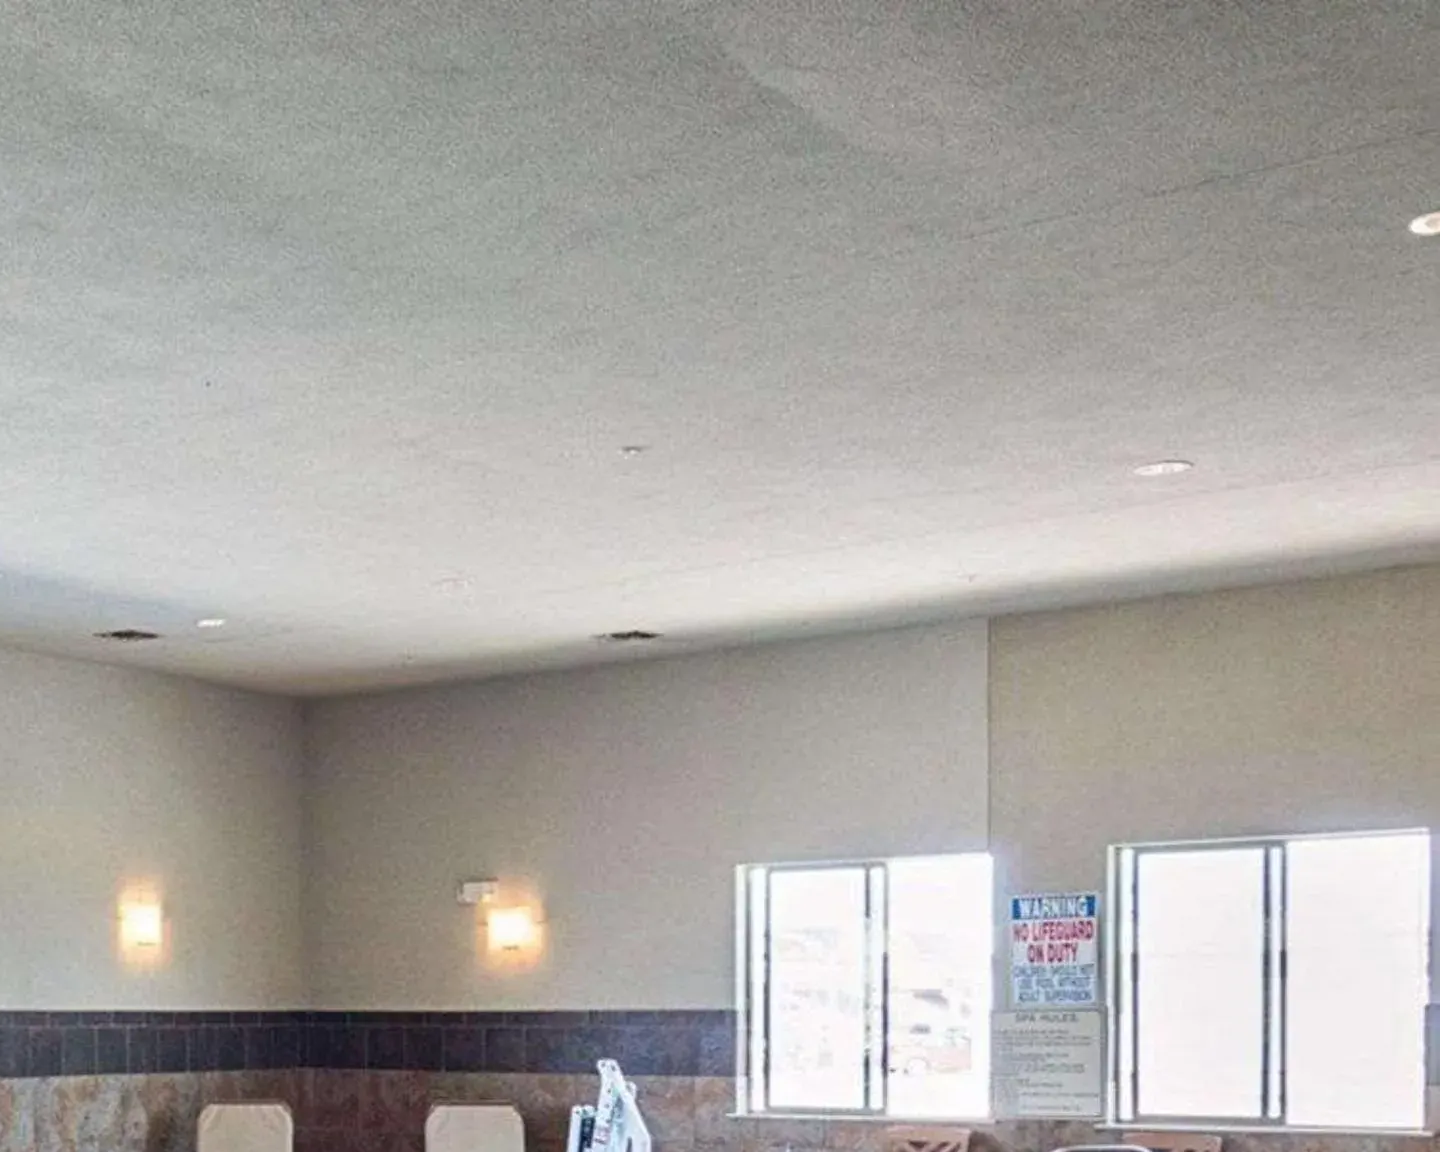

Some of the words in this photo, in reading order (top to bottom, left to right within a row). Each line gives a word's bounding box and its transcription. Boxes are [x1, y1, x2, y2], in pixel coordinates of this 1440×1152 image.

[1018, 897, 1087, 919] WARNING
[1013, 922, 1029, 941] NO
[1031, 920, 1093, 940] LIFEGUARD
[1027, 943, 1044, 962] ON
[1047, 941, 1077, 962] DUTY
